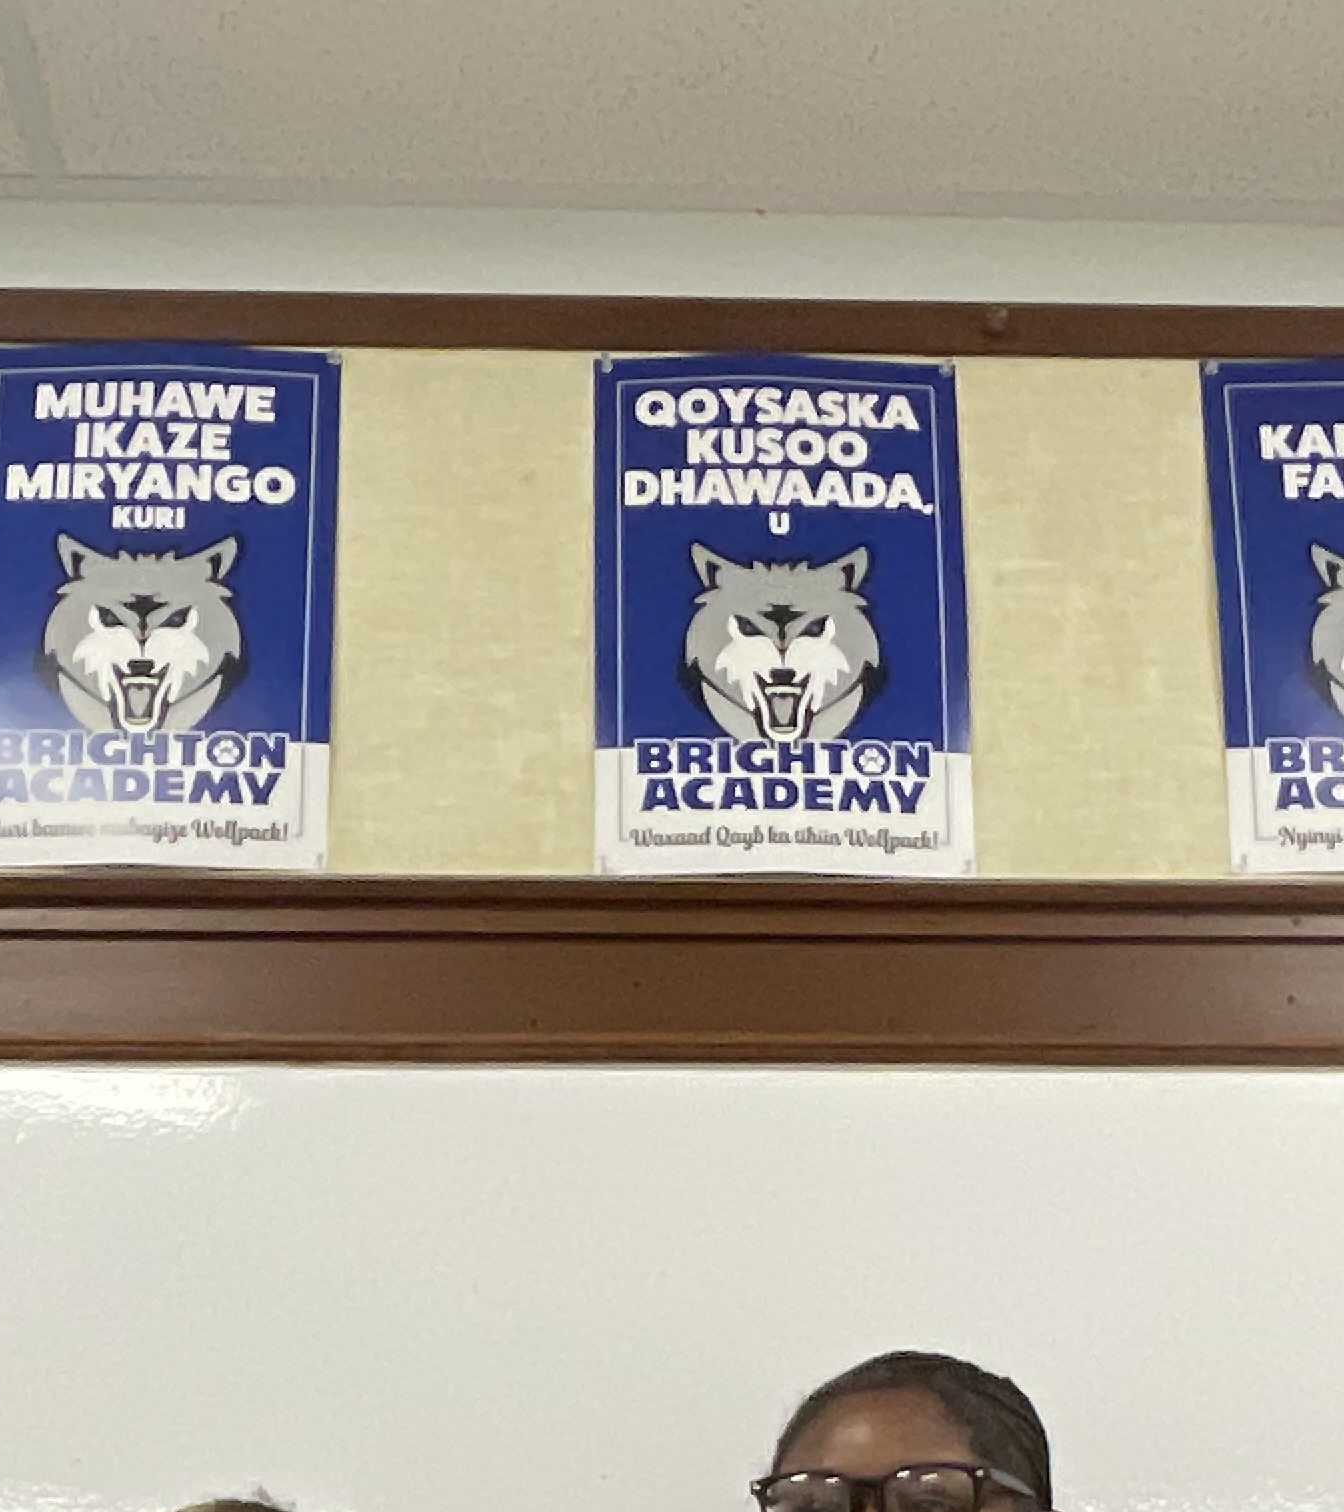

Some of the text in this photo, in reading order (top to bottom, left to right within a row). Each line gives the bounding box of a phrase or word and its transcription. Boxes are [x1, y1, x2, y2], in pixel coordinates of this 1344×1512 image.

[35, 381, 276, 422] MUHAWE
[634, 388, 920, 431] QOYSASKA
[73, 421, 232, 460] IKAZE
[686, 428, 869, 468] KUSOO
[4, 463, 296, 505] MIRYANGO
[111, 504, 186, 531] KURI
[768, 512, 790, 535] U
[636, 739, 933, 778] BRIGHTON
[640, 777, 926, 815] ACADEMY
